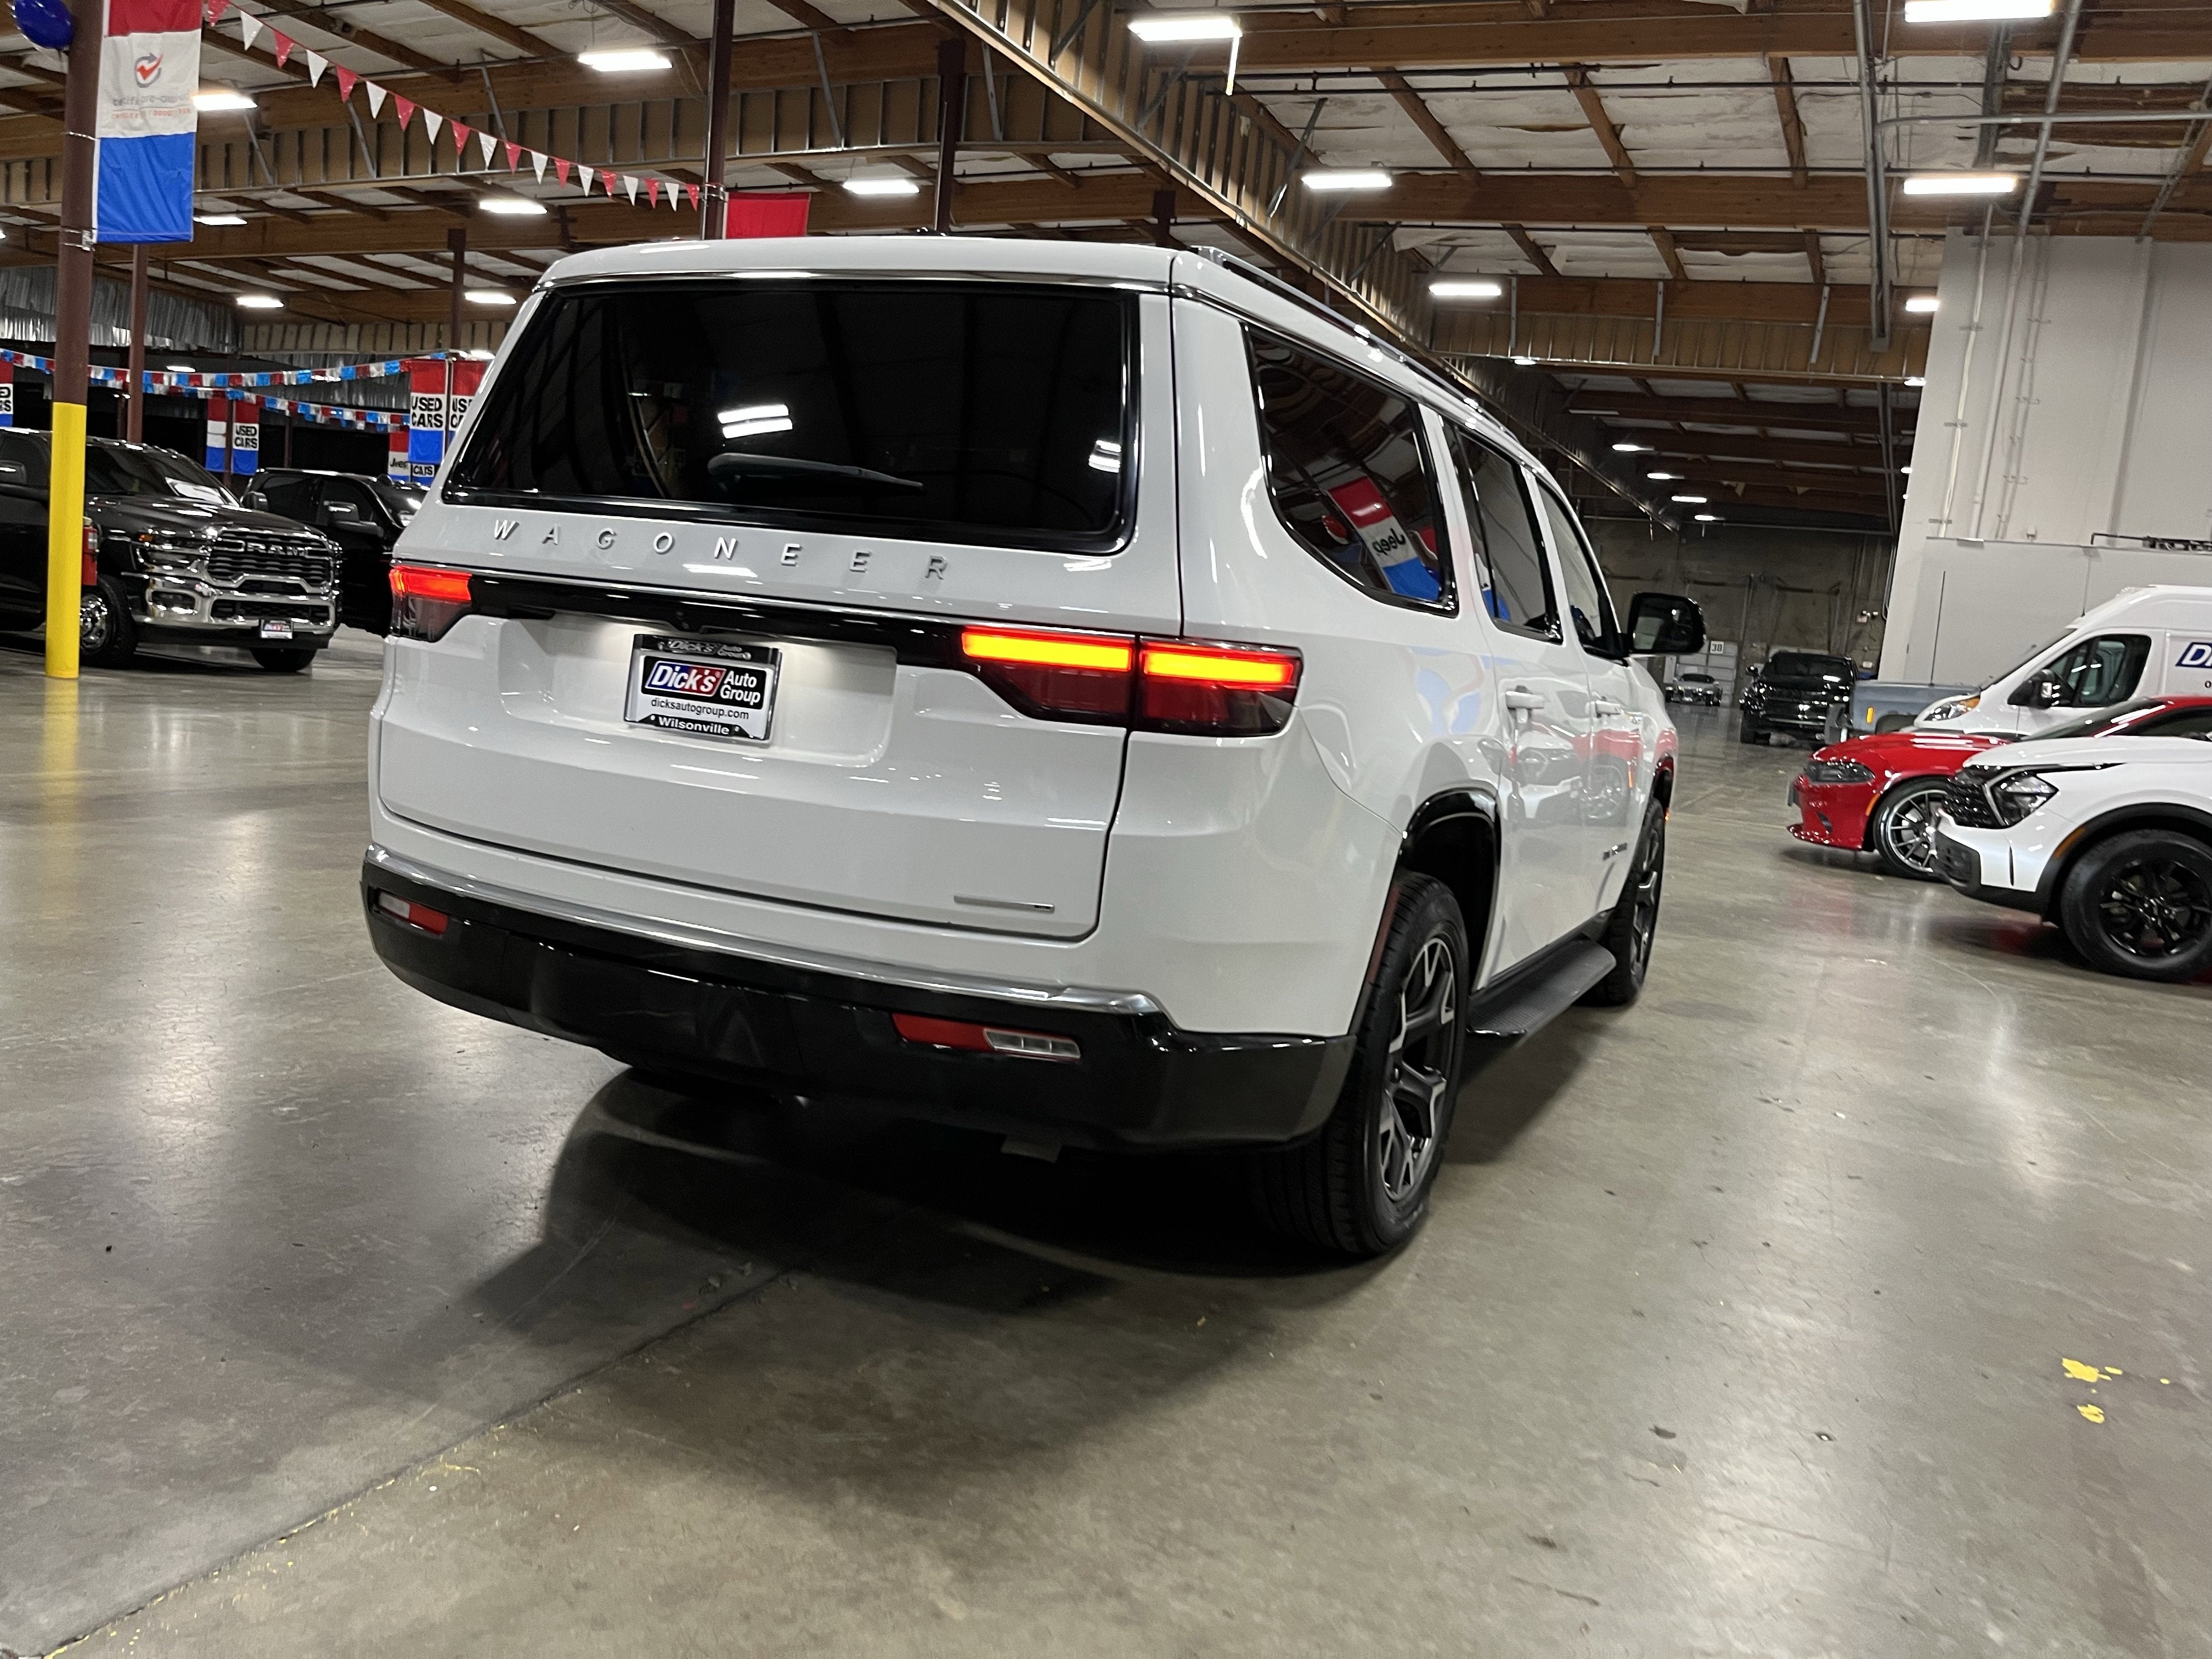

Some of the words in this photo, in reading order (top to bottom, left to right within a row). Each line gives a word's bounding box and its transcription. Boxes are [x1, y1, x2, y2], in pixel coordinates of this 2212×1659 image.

[411, 396, 442, 411] USED
[411, 412, 443, 428] CARS
[235, 425, 257, 436] USED
[235, 437, 257, 448] CARS
[247, 542, 305, 556] RAM
[493, 518, 949, 580] WAGONEER
[651, 665, 716, 692] Dick's
[724, 670, 757, 688] Auto
[720, 684, 761, 706] Group
[651, 697, 749, 720] dicksautogroup.com
[658, 716, 730, 735] Wilsonville
